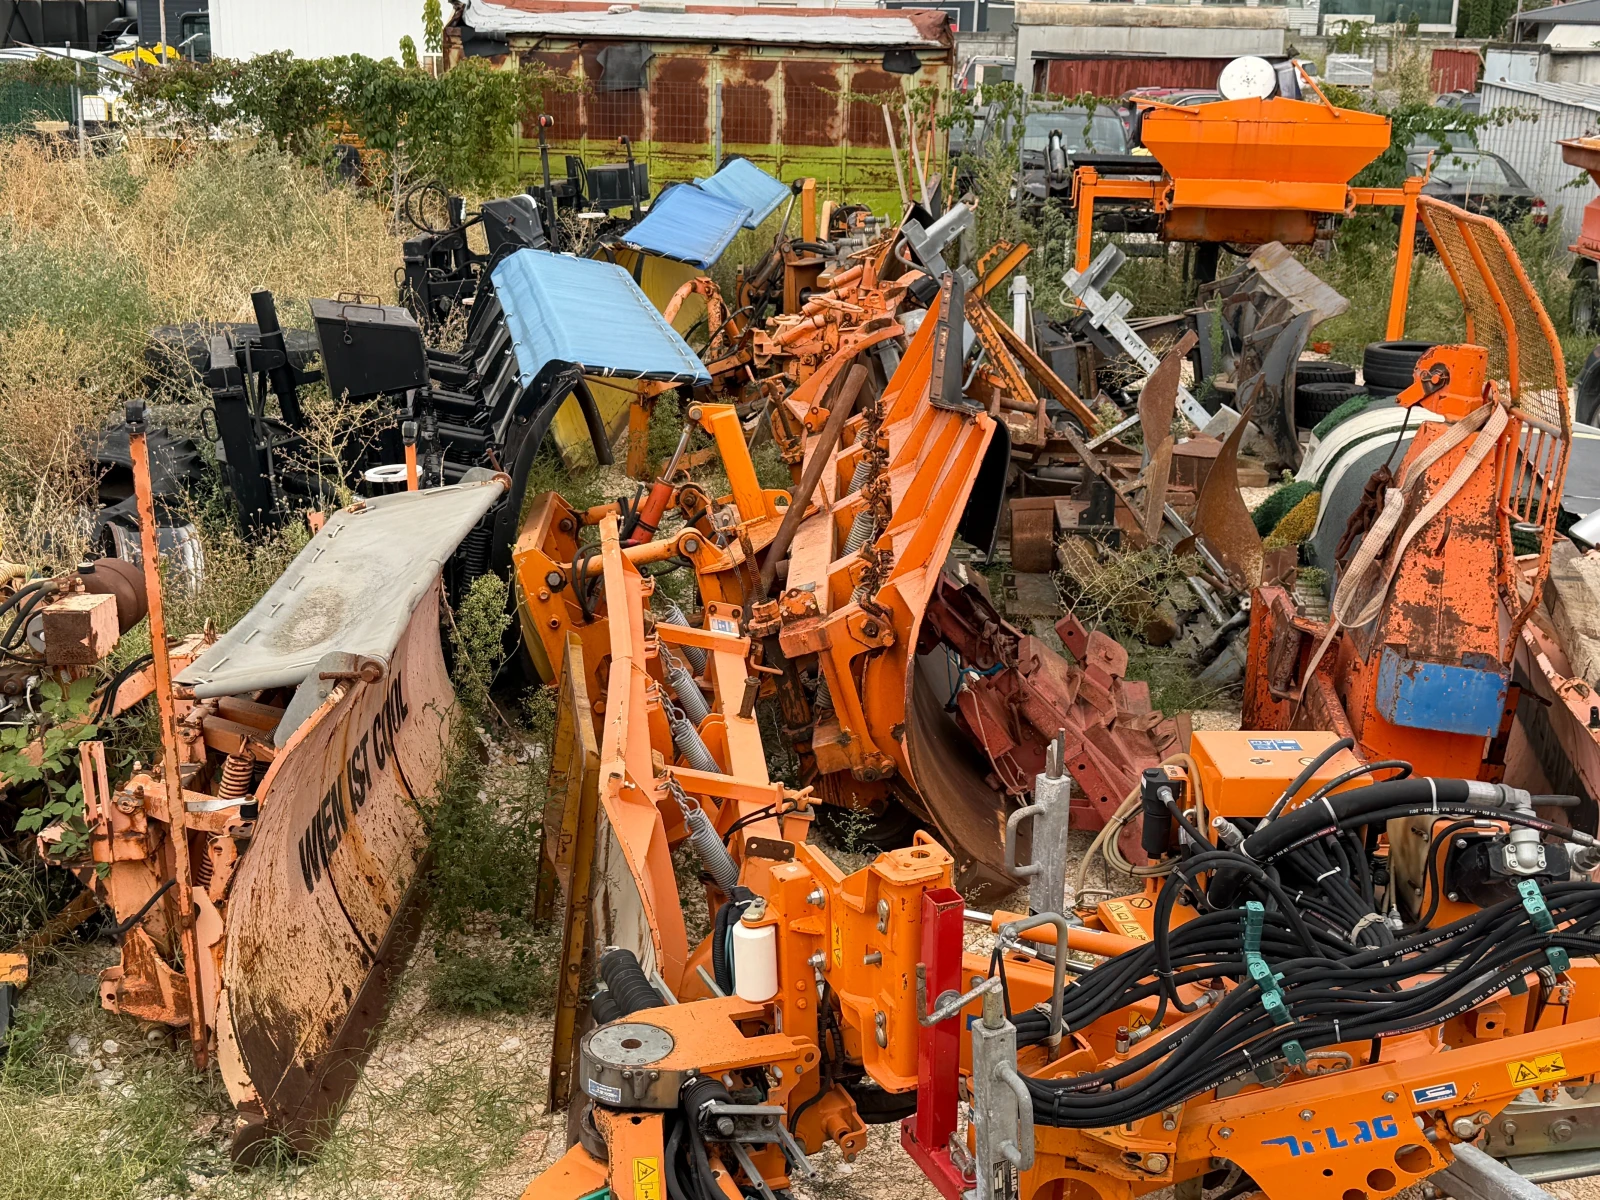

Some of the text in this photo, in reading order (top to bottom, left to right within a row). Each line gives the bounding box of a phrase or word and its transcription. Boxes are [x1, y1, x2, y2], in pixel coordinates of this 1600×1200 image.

[298, 670, 409, 895] WIEN IST COOL
[1507, 972, 1518, 984] BAR
[1261, 1114, 1399, 1157] LAG
